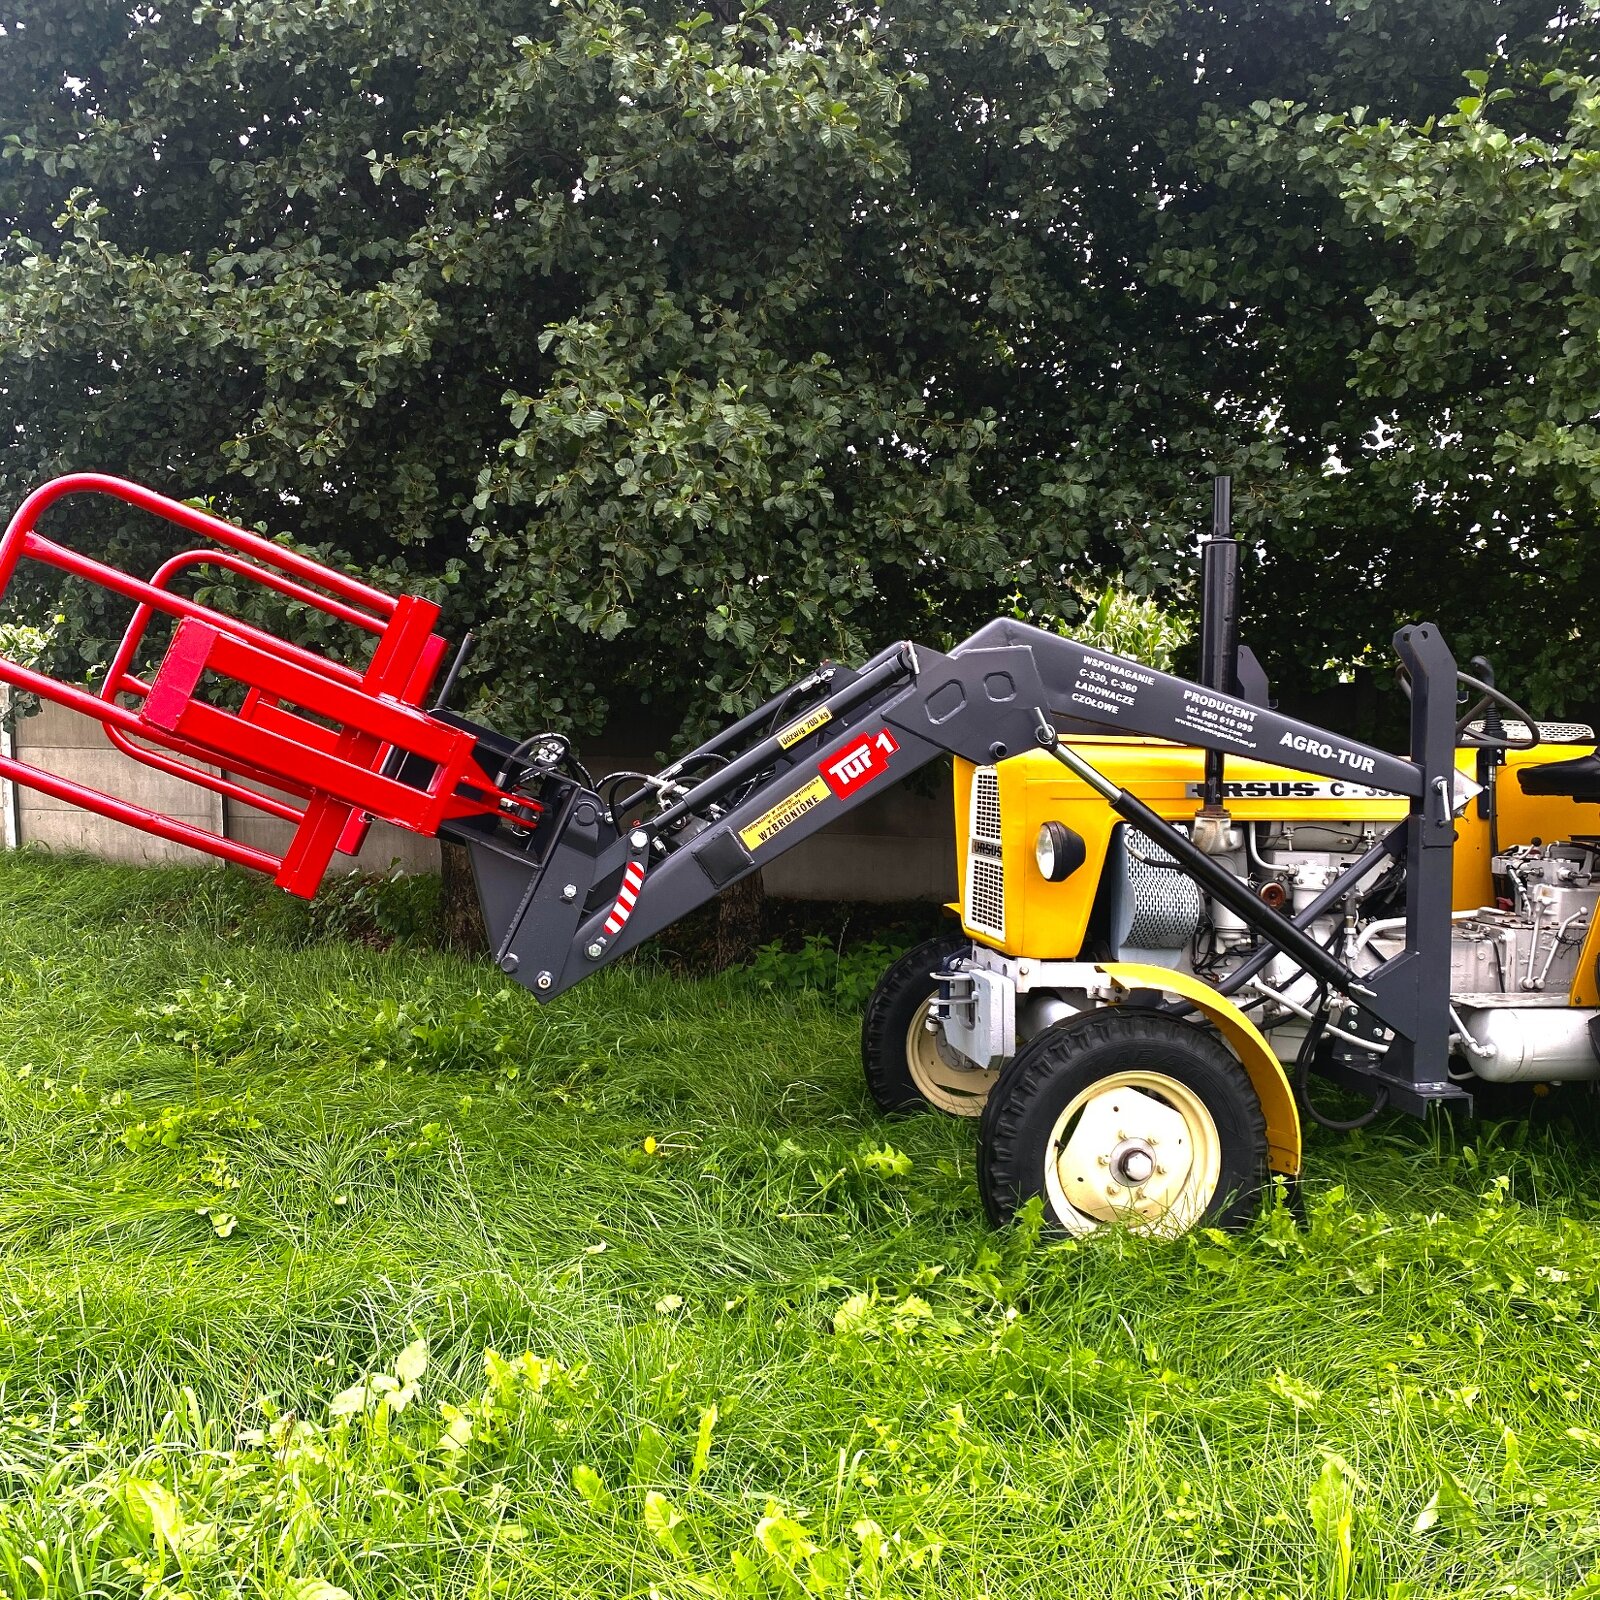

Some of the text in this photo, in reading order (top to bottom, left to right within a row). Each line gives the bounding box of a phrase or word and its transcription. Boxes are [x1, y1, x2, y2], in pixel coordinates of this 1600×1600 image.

[1079, 668, 1138, 693] C-330, C-360
[1083, 655, 1156, 686] WSPOMAGANIE
[1071, 692, 1120, 714] CZOŁOWE
[1074, 680, 1136, 706] ŁADOWACZE
[1183, 689, 1259, 722] PRODUCENT
[804, 716, 819, 729] 700
[818, 711, 830, 720] kg
[1185, 704, 1253, 733] tel. 660 616 099
[875, 732, 895, 754] 1
[1279, 731, 1377, 774] AGRO-TUR
[1330, 782, 1345, 797] C
[758, 794, 820, 841] WZBRONIONE
[973, 841, 1003, 858] URSUS
